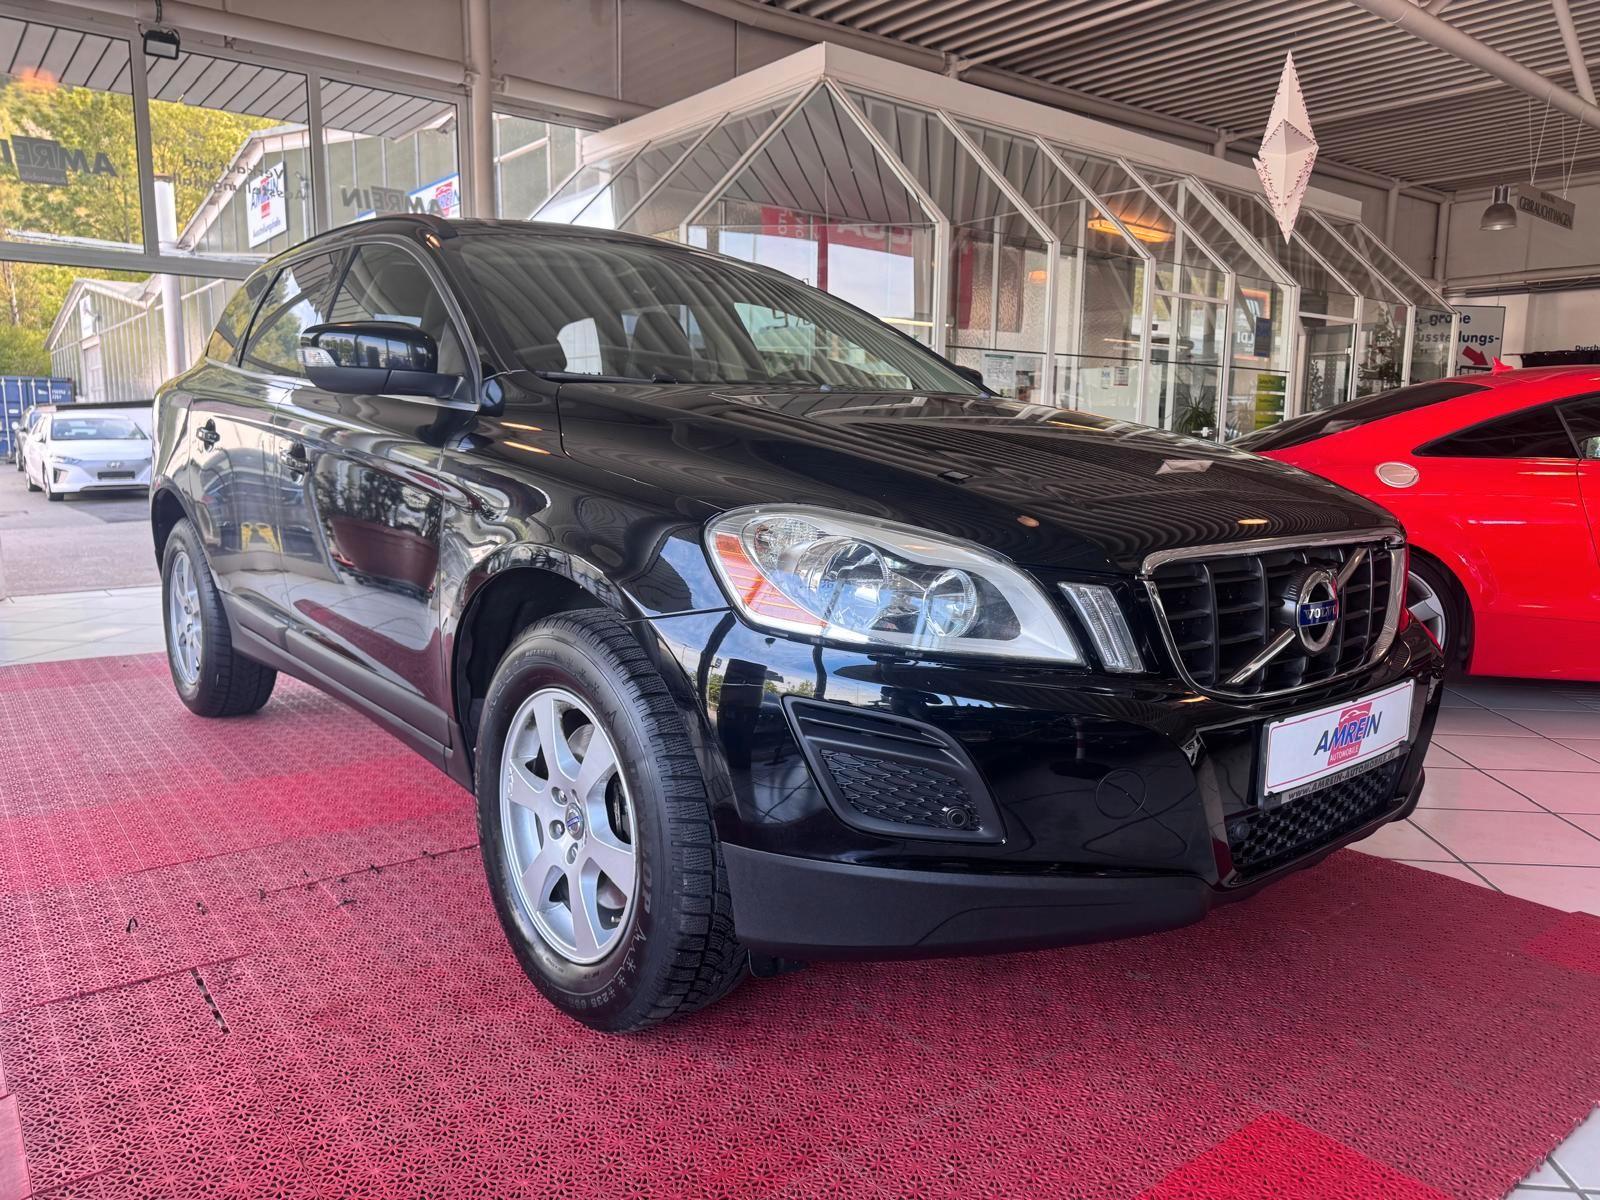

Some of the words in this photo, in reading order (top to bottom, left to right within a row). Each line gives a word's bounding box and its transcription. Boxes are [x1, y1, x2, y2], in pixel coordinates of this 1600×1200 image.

[1430, 312, 1471, 326] groe
[1313, 711, 1382, 756] AMREIN
[1329, 744, 1359, 762] AUTOMOBILE
